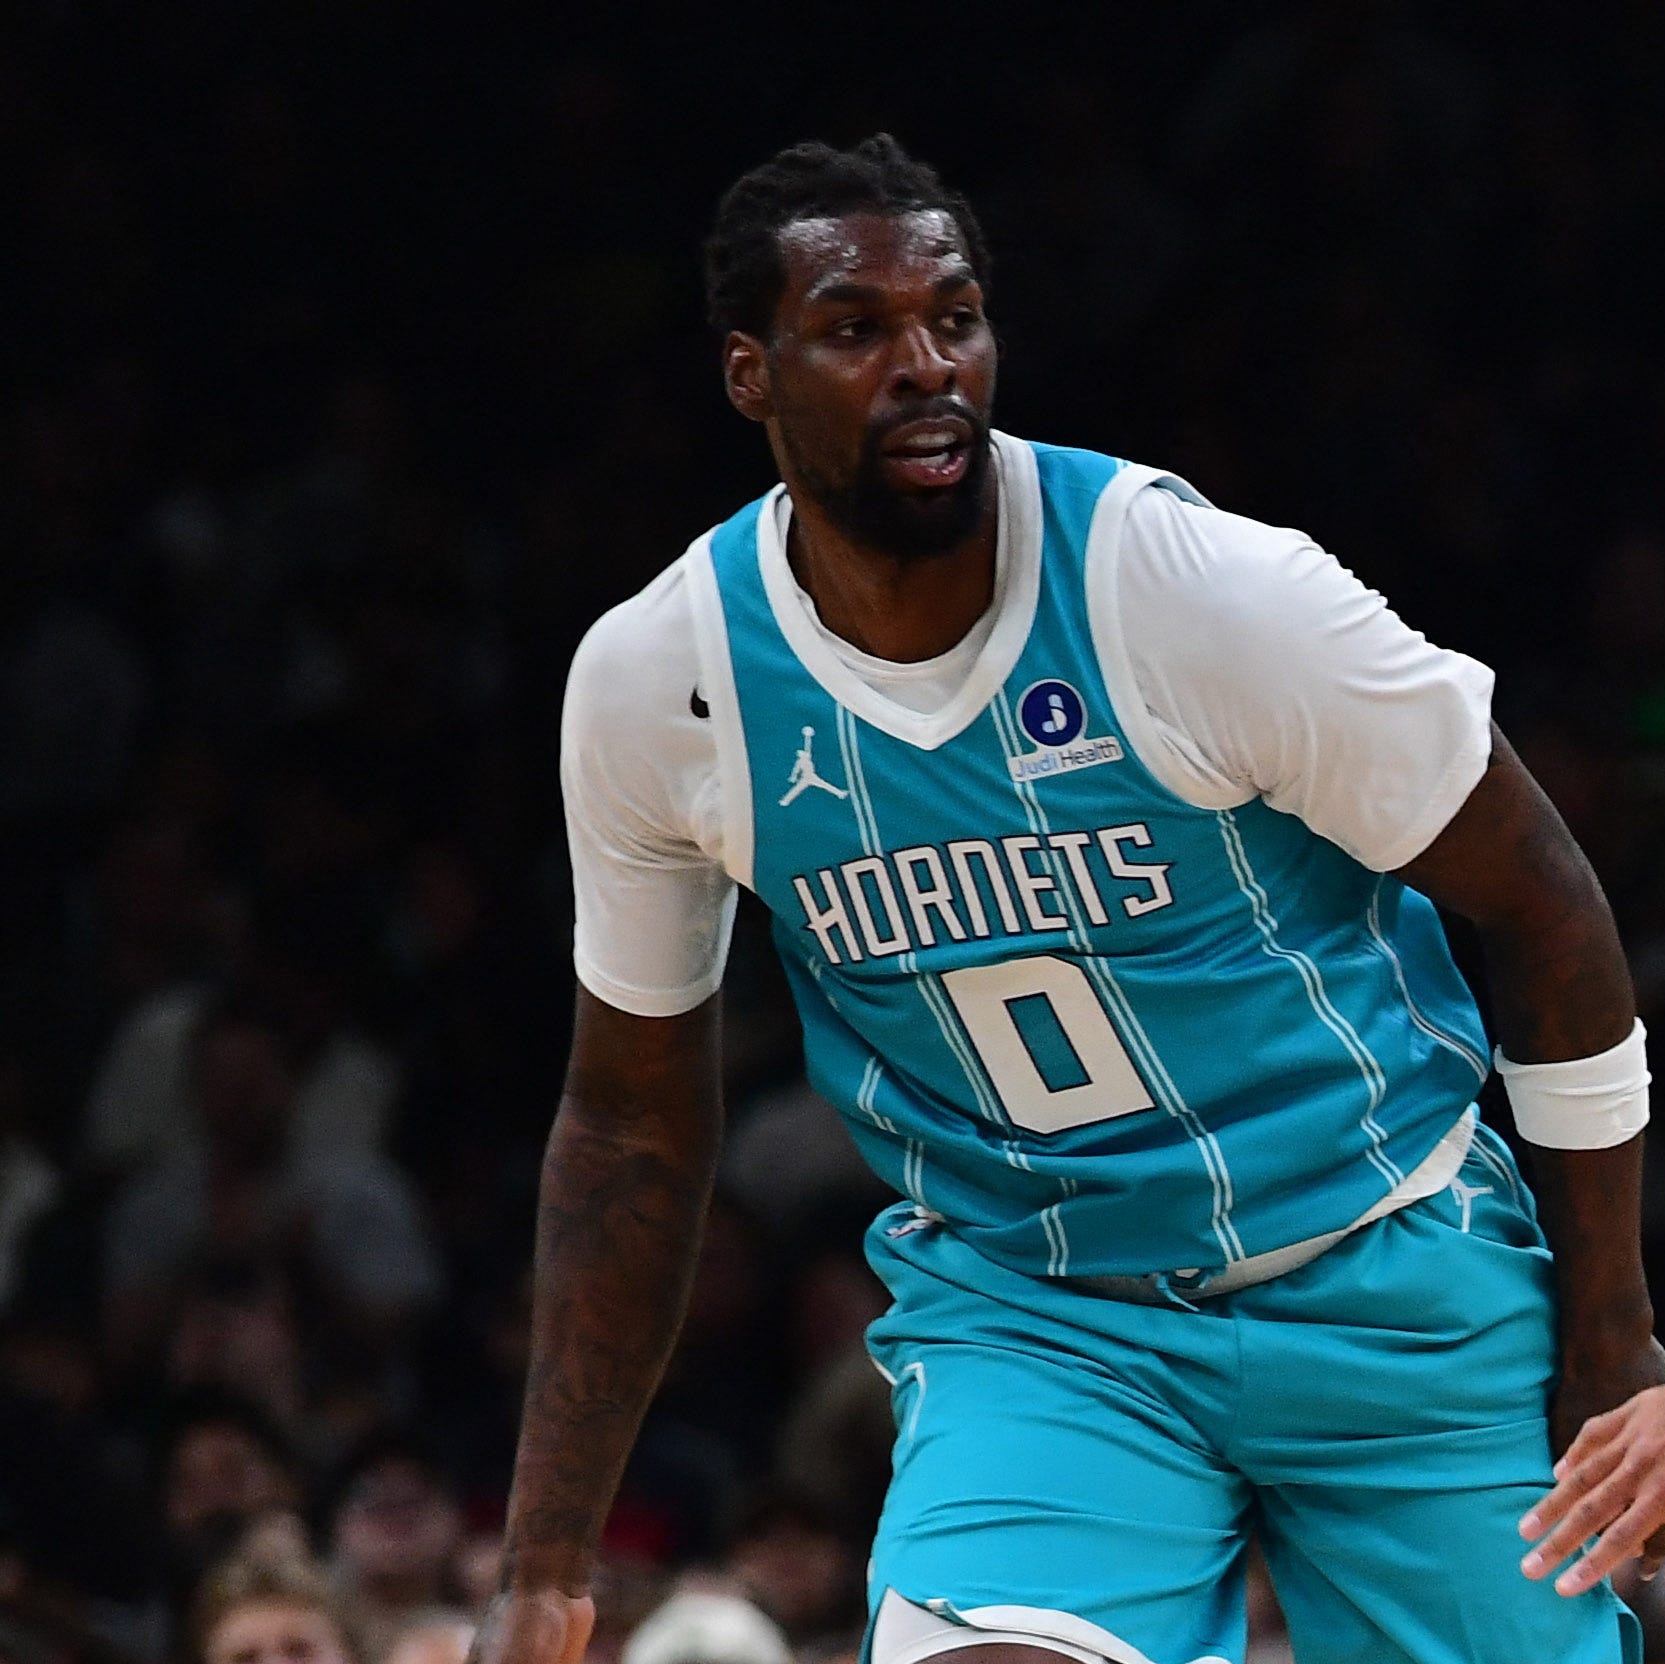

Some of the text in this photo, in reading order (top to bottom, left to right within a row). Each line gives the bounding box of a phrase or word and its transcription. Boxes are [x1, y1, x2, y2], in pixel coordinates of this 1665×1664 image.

[1015, 740, 1120, 778] Judi Health
[791, 821, 1174, 966] HORNETS
[939, 954, 1158, 1135] 0
